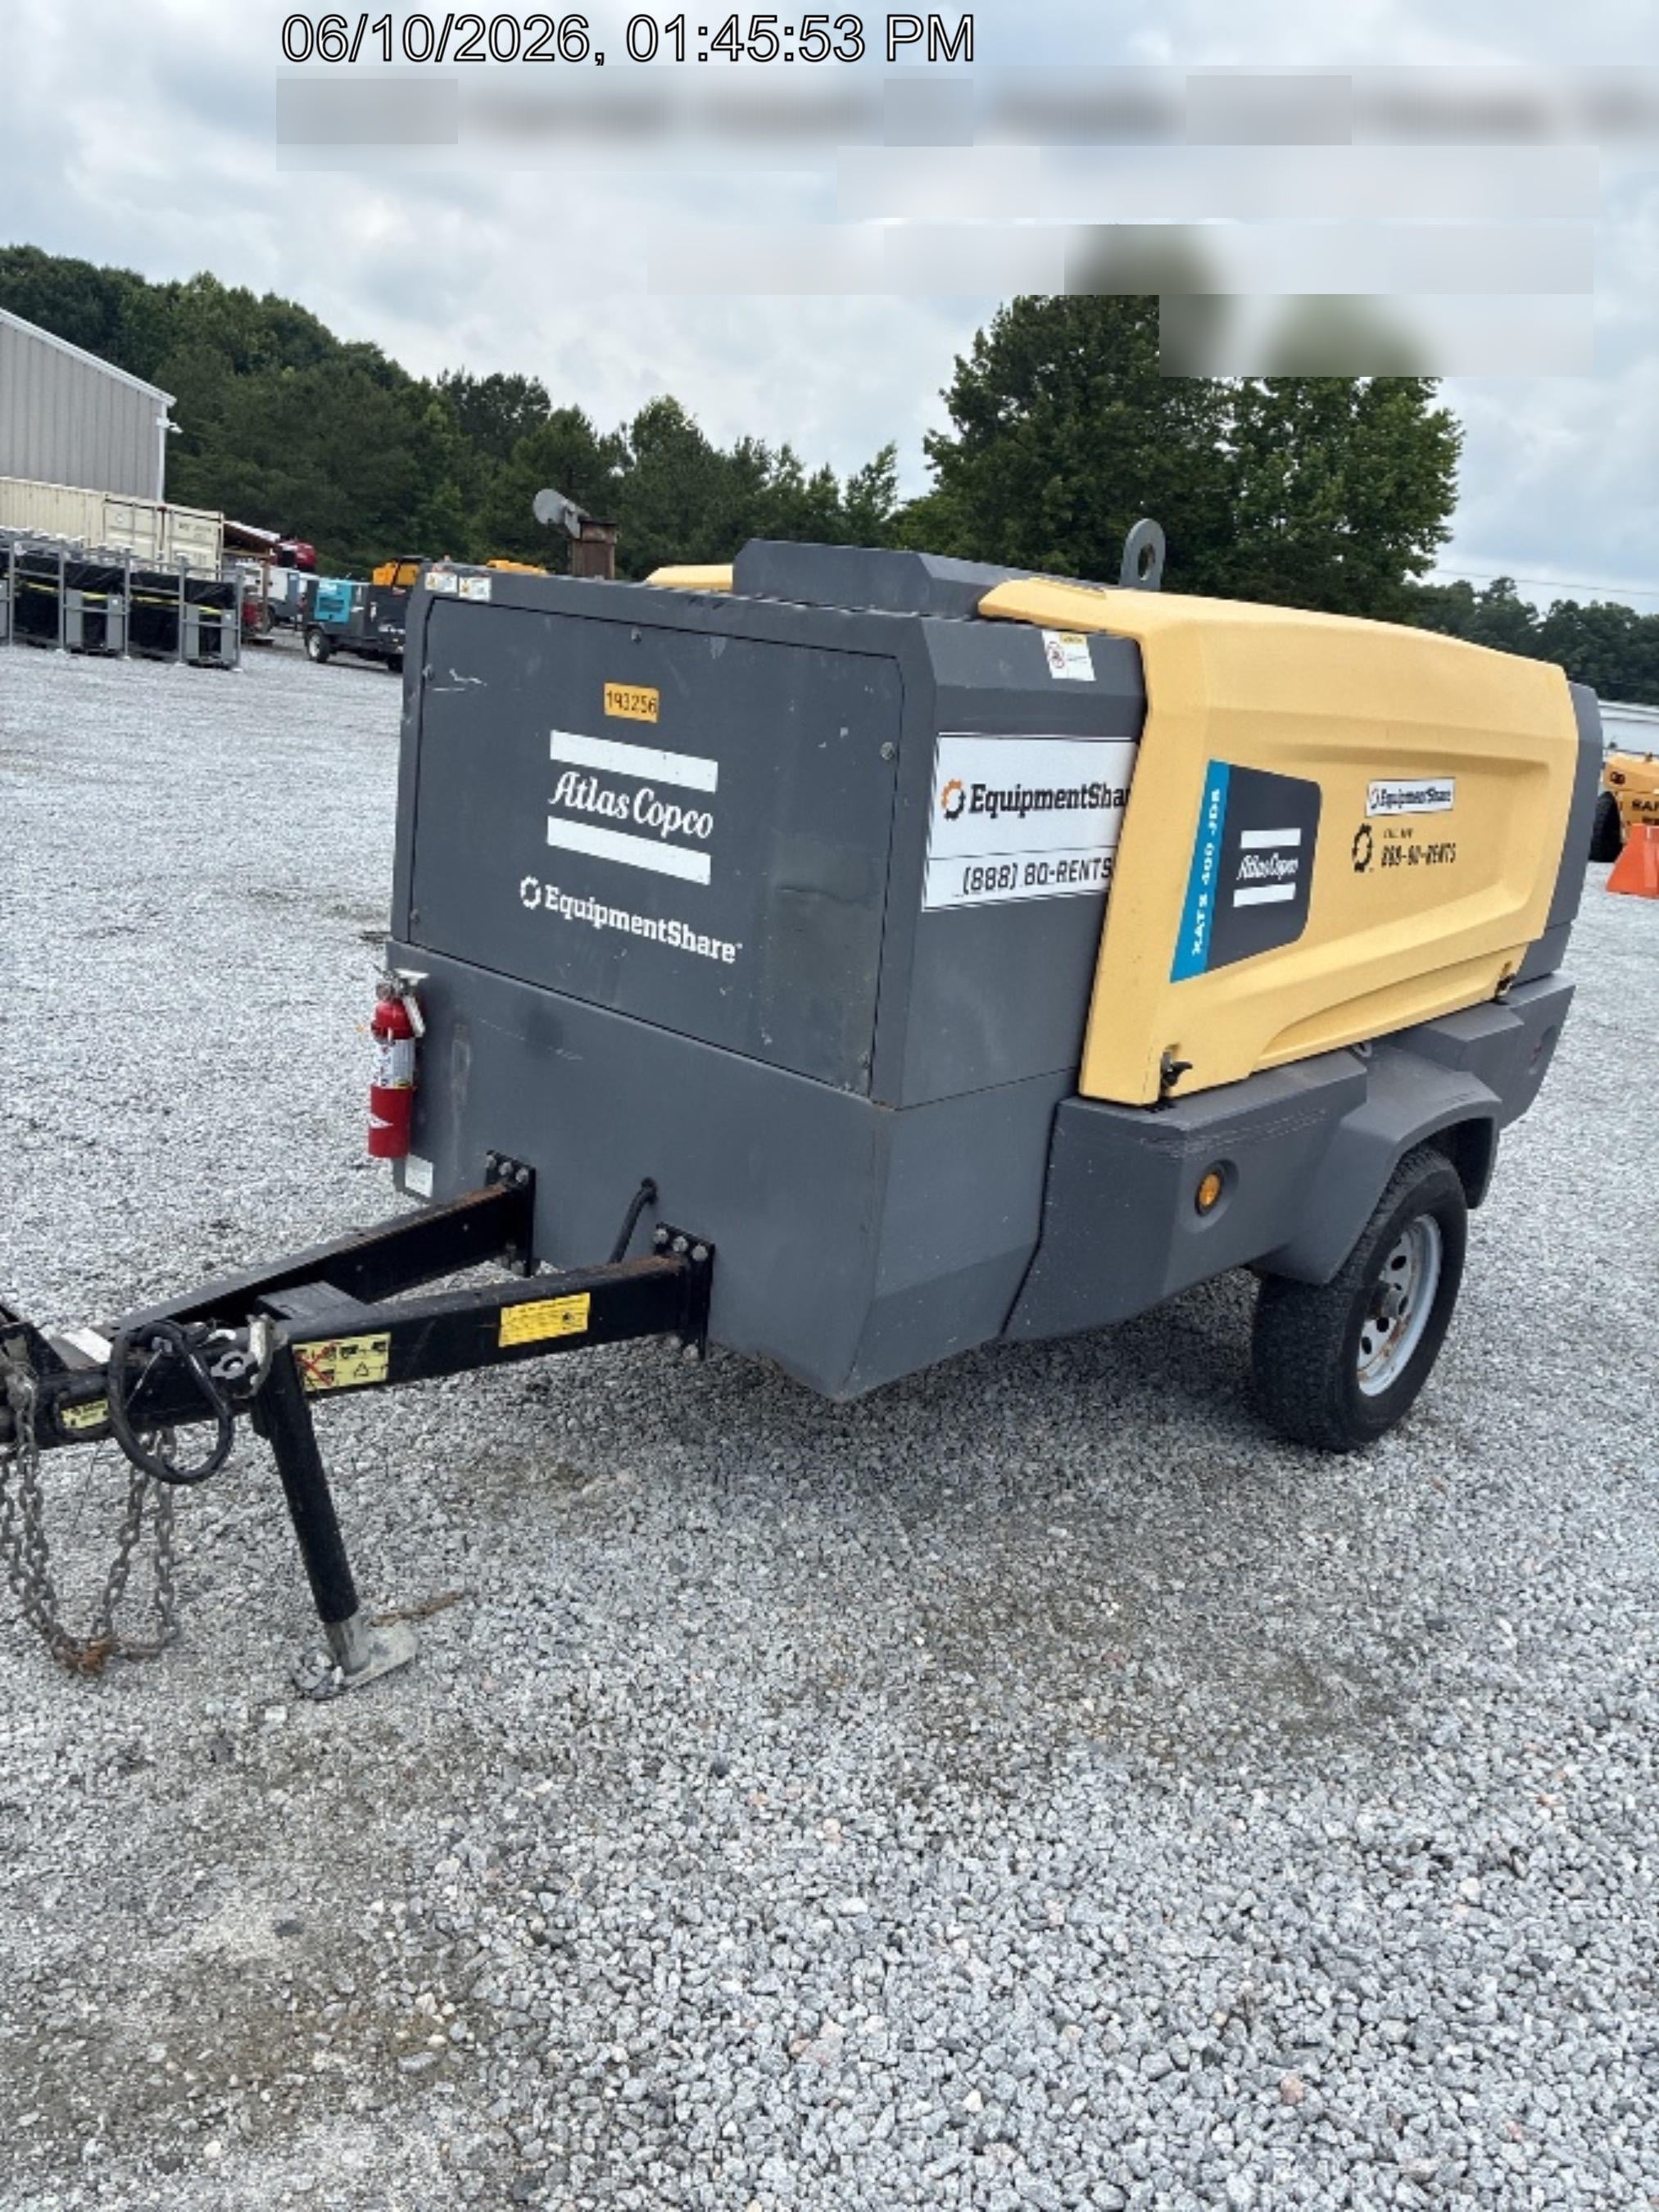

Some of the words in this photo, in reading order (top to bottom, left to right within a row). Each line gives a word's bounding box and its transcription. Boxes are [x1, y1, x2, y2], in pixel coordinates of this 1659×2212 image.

[548, 769, 631, 821] Atlas
[632, 787, 714, 841] Copco
[963, 863, 1018, 895] (888)
[1024, 857, 1113, 886] 80-RENTS
[543, 883, 737, 964] EquipmentShare
